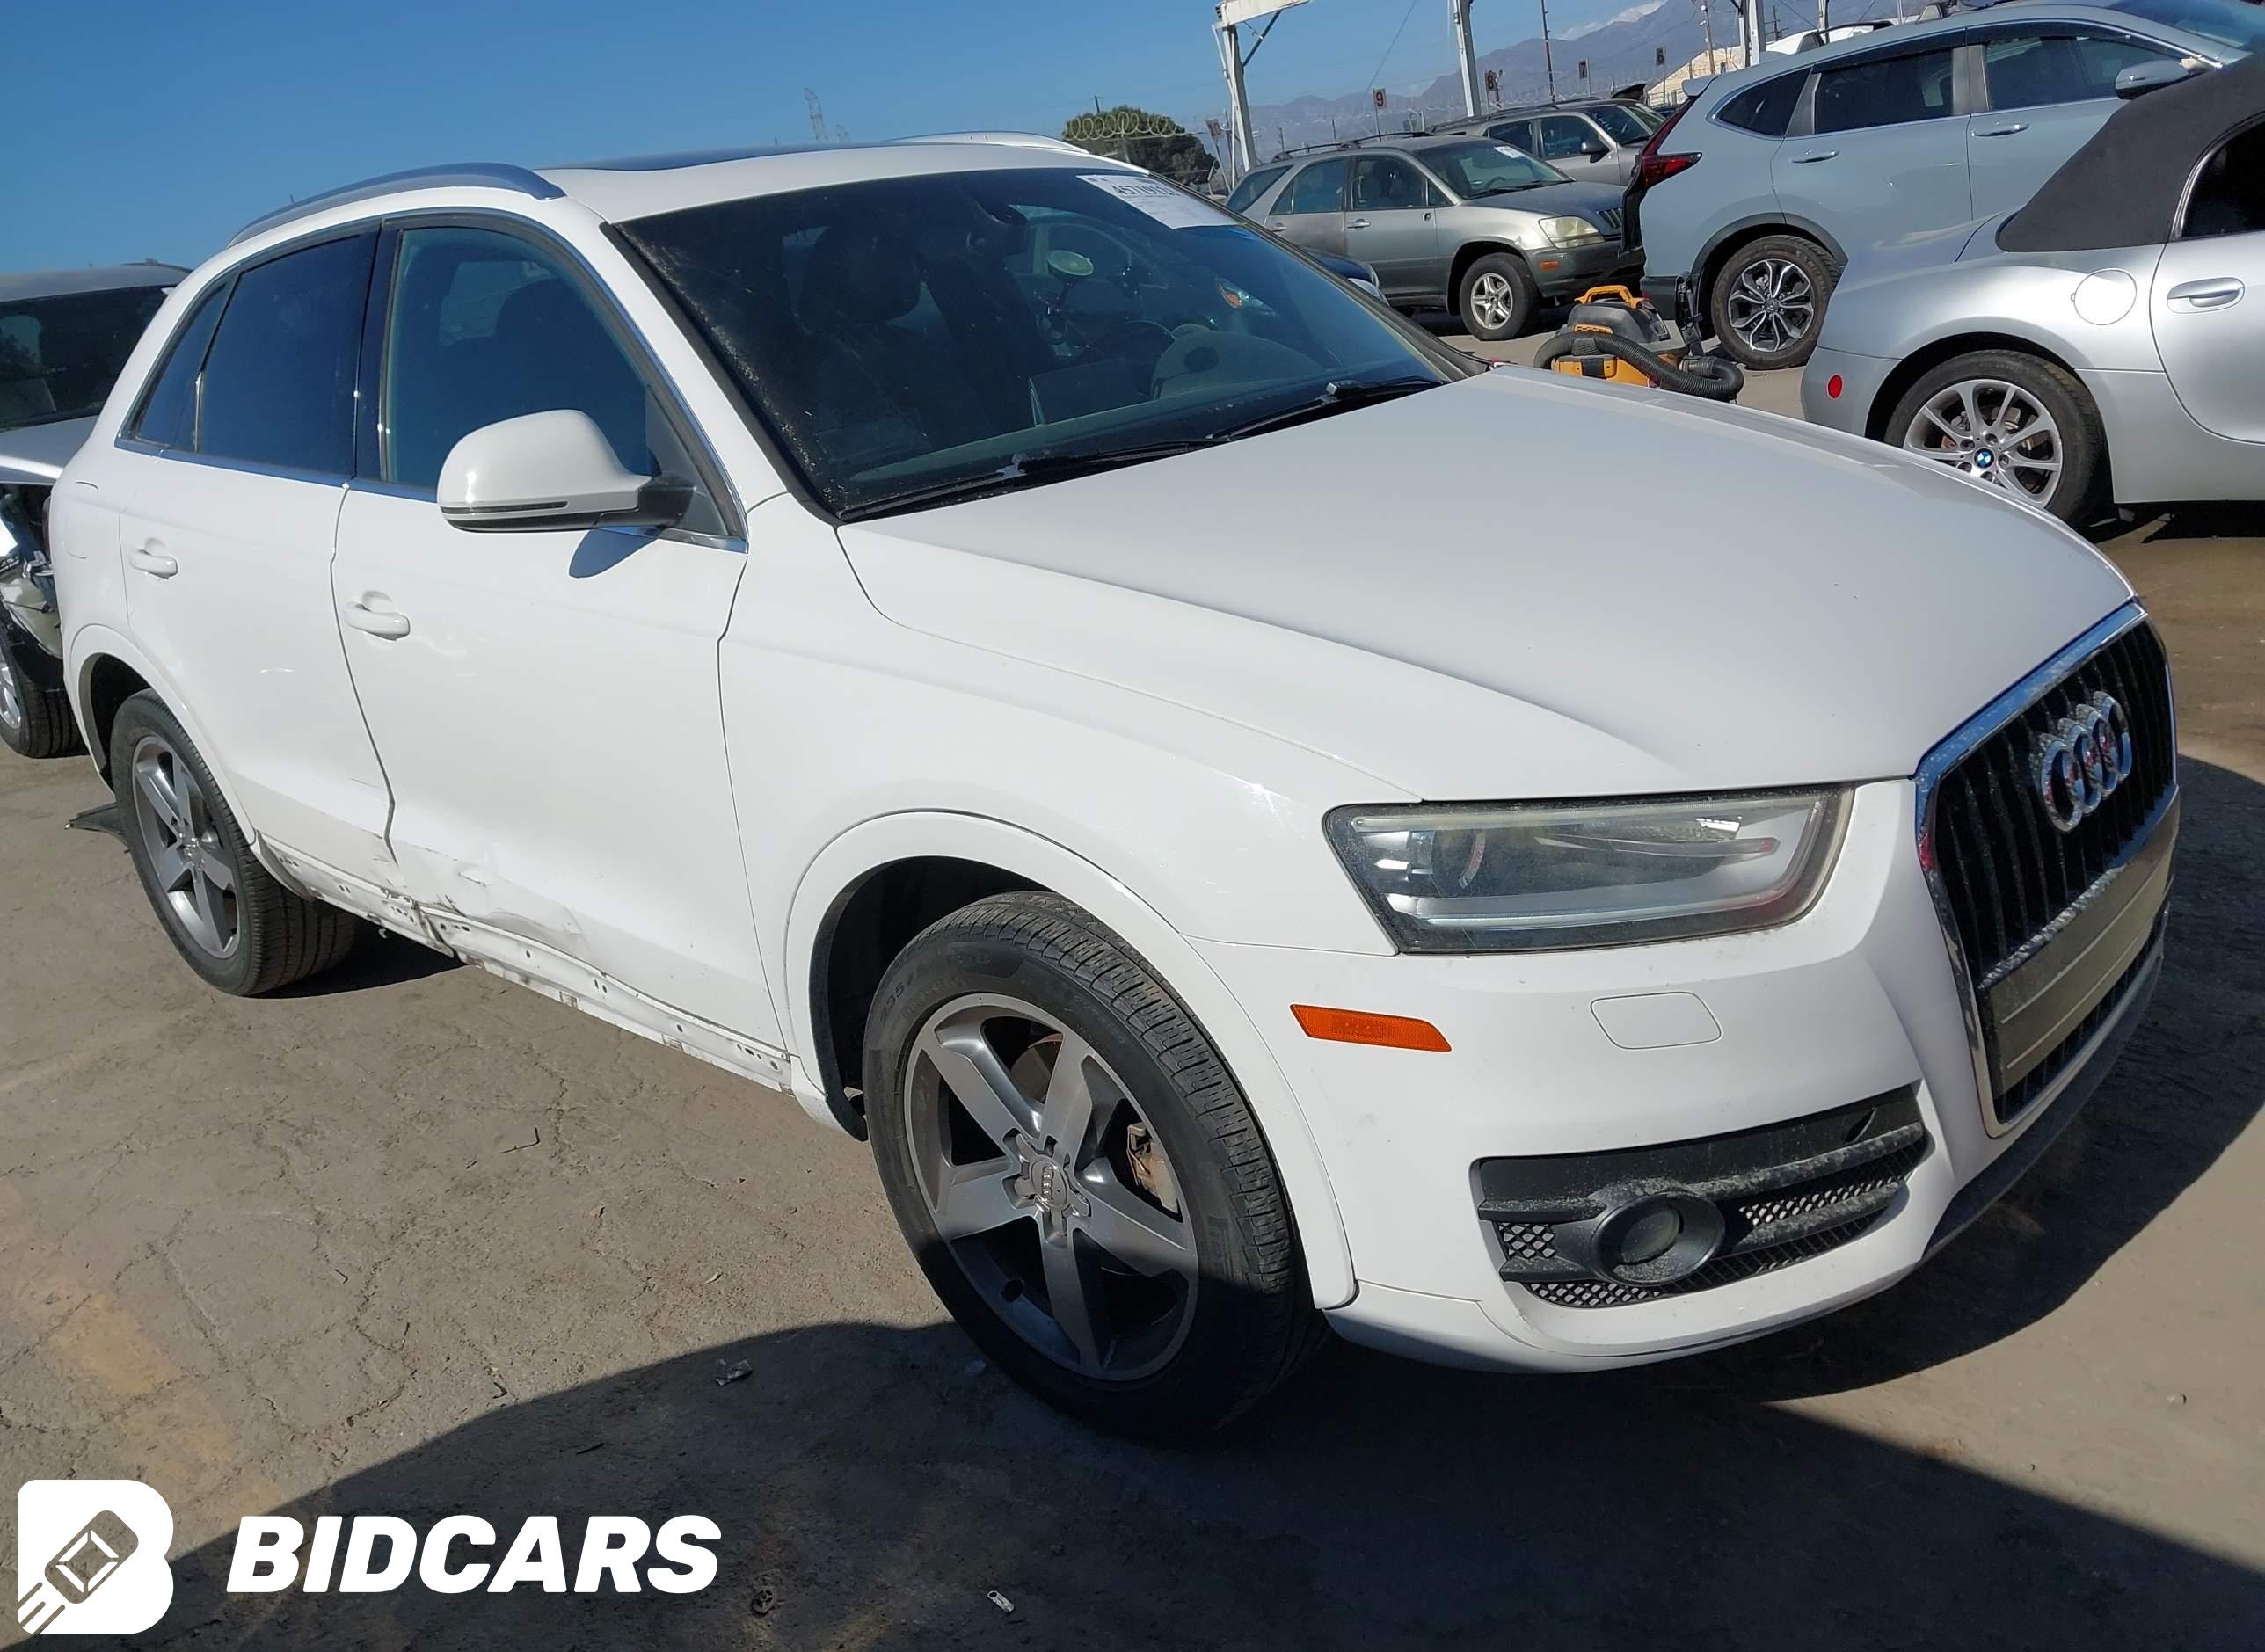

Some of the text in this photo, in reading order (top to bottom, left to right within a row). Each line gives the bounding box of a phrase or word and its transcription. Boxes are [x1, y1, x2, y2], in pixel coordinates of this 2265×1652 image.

[1580, 62, 1586, 77] 7
[1487, 74, 1494, 90] 8
[1375, 91, 1384, 106] 9
